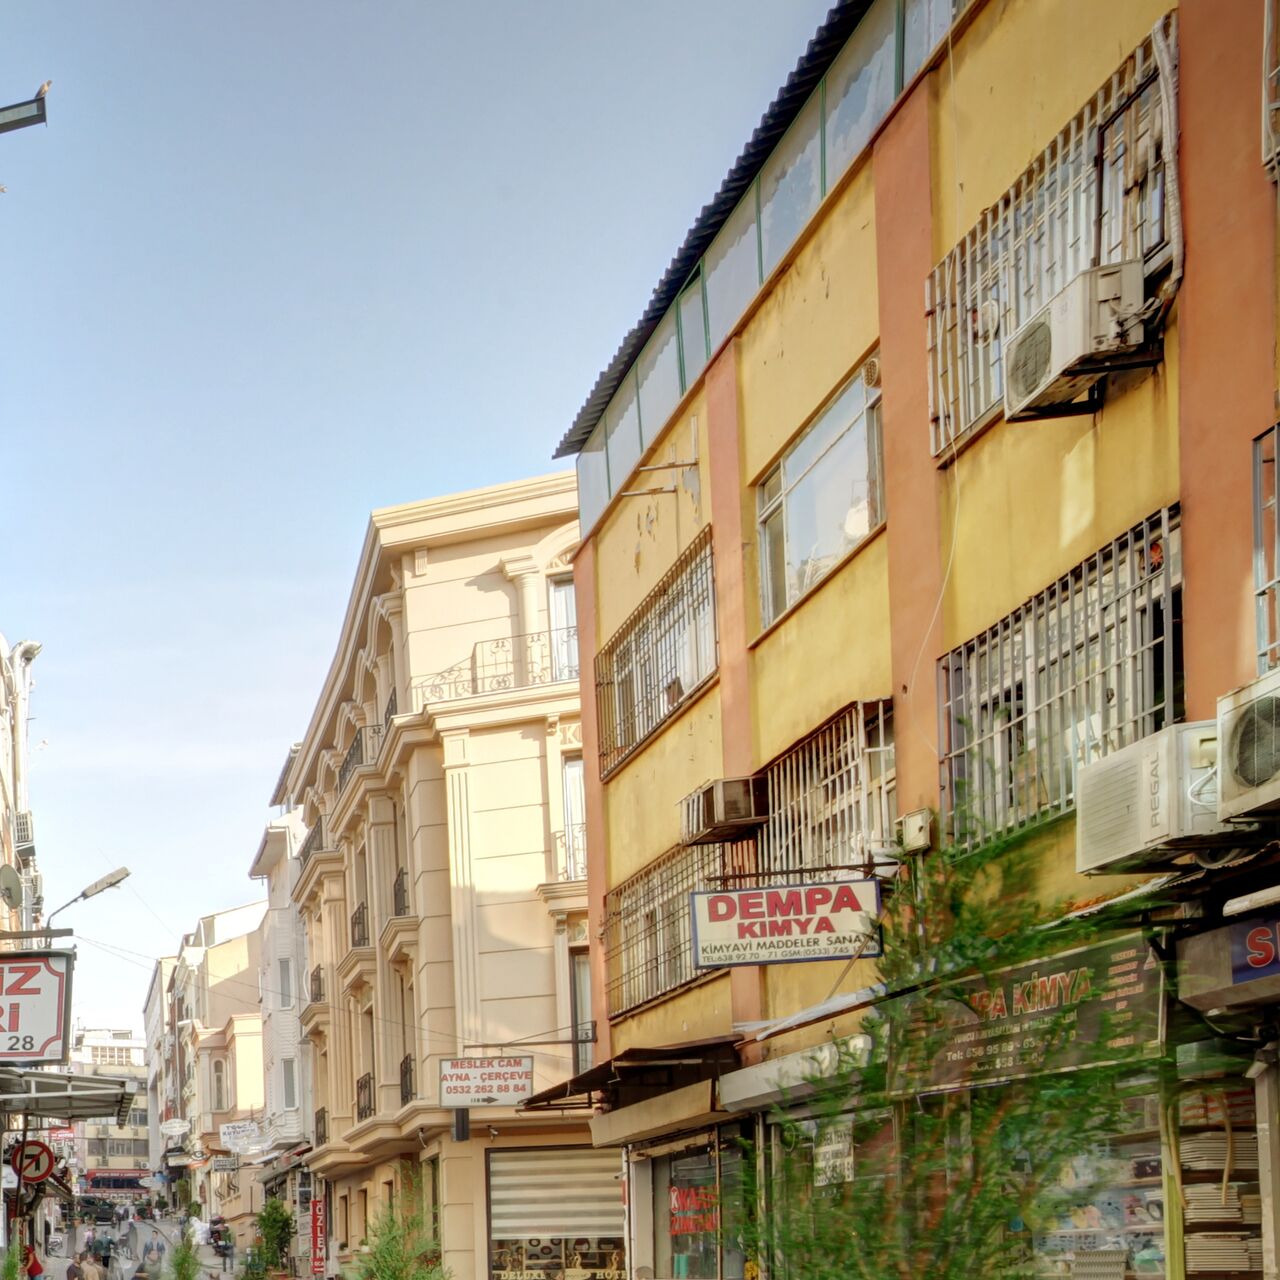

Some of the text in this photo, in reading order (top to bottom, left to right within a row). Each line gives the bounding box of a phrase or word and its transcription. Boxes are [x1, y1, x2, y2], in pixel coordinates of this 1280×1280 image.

[1150, 751, 1160, 828] REGAL
[707, 885, 863, 922] DEMPA
[757, 937, 820, 950] MADDELER
[748, 952, 760, 960] 70
[767, 951, 778, 959] 71
[1012, 967, 1092, 1017] KİMYA
[7, 1035, 34, 1051] 28
[946, 1050, 965, 1062] Tel:
[451, 1058, 523, 1069] MESLEK CAM
[441, 1073, 471, 1082] AYNA
[480, 1071, 532, 1083] ÇERÇEVE
[446, 1085, 472, 1094] 0532
[474, 1084, 494, 1093] 262
